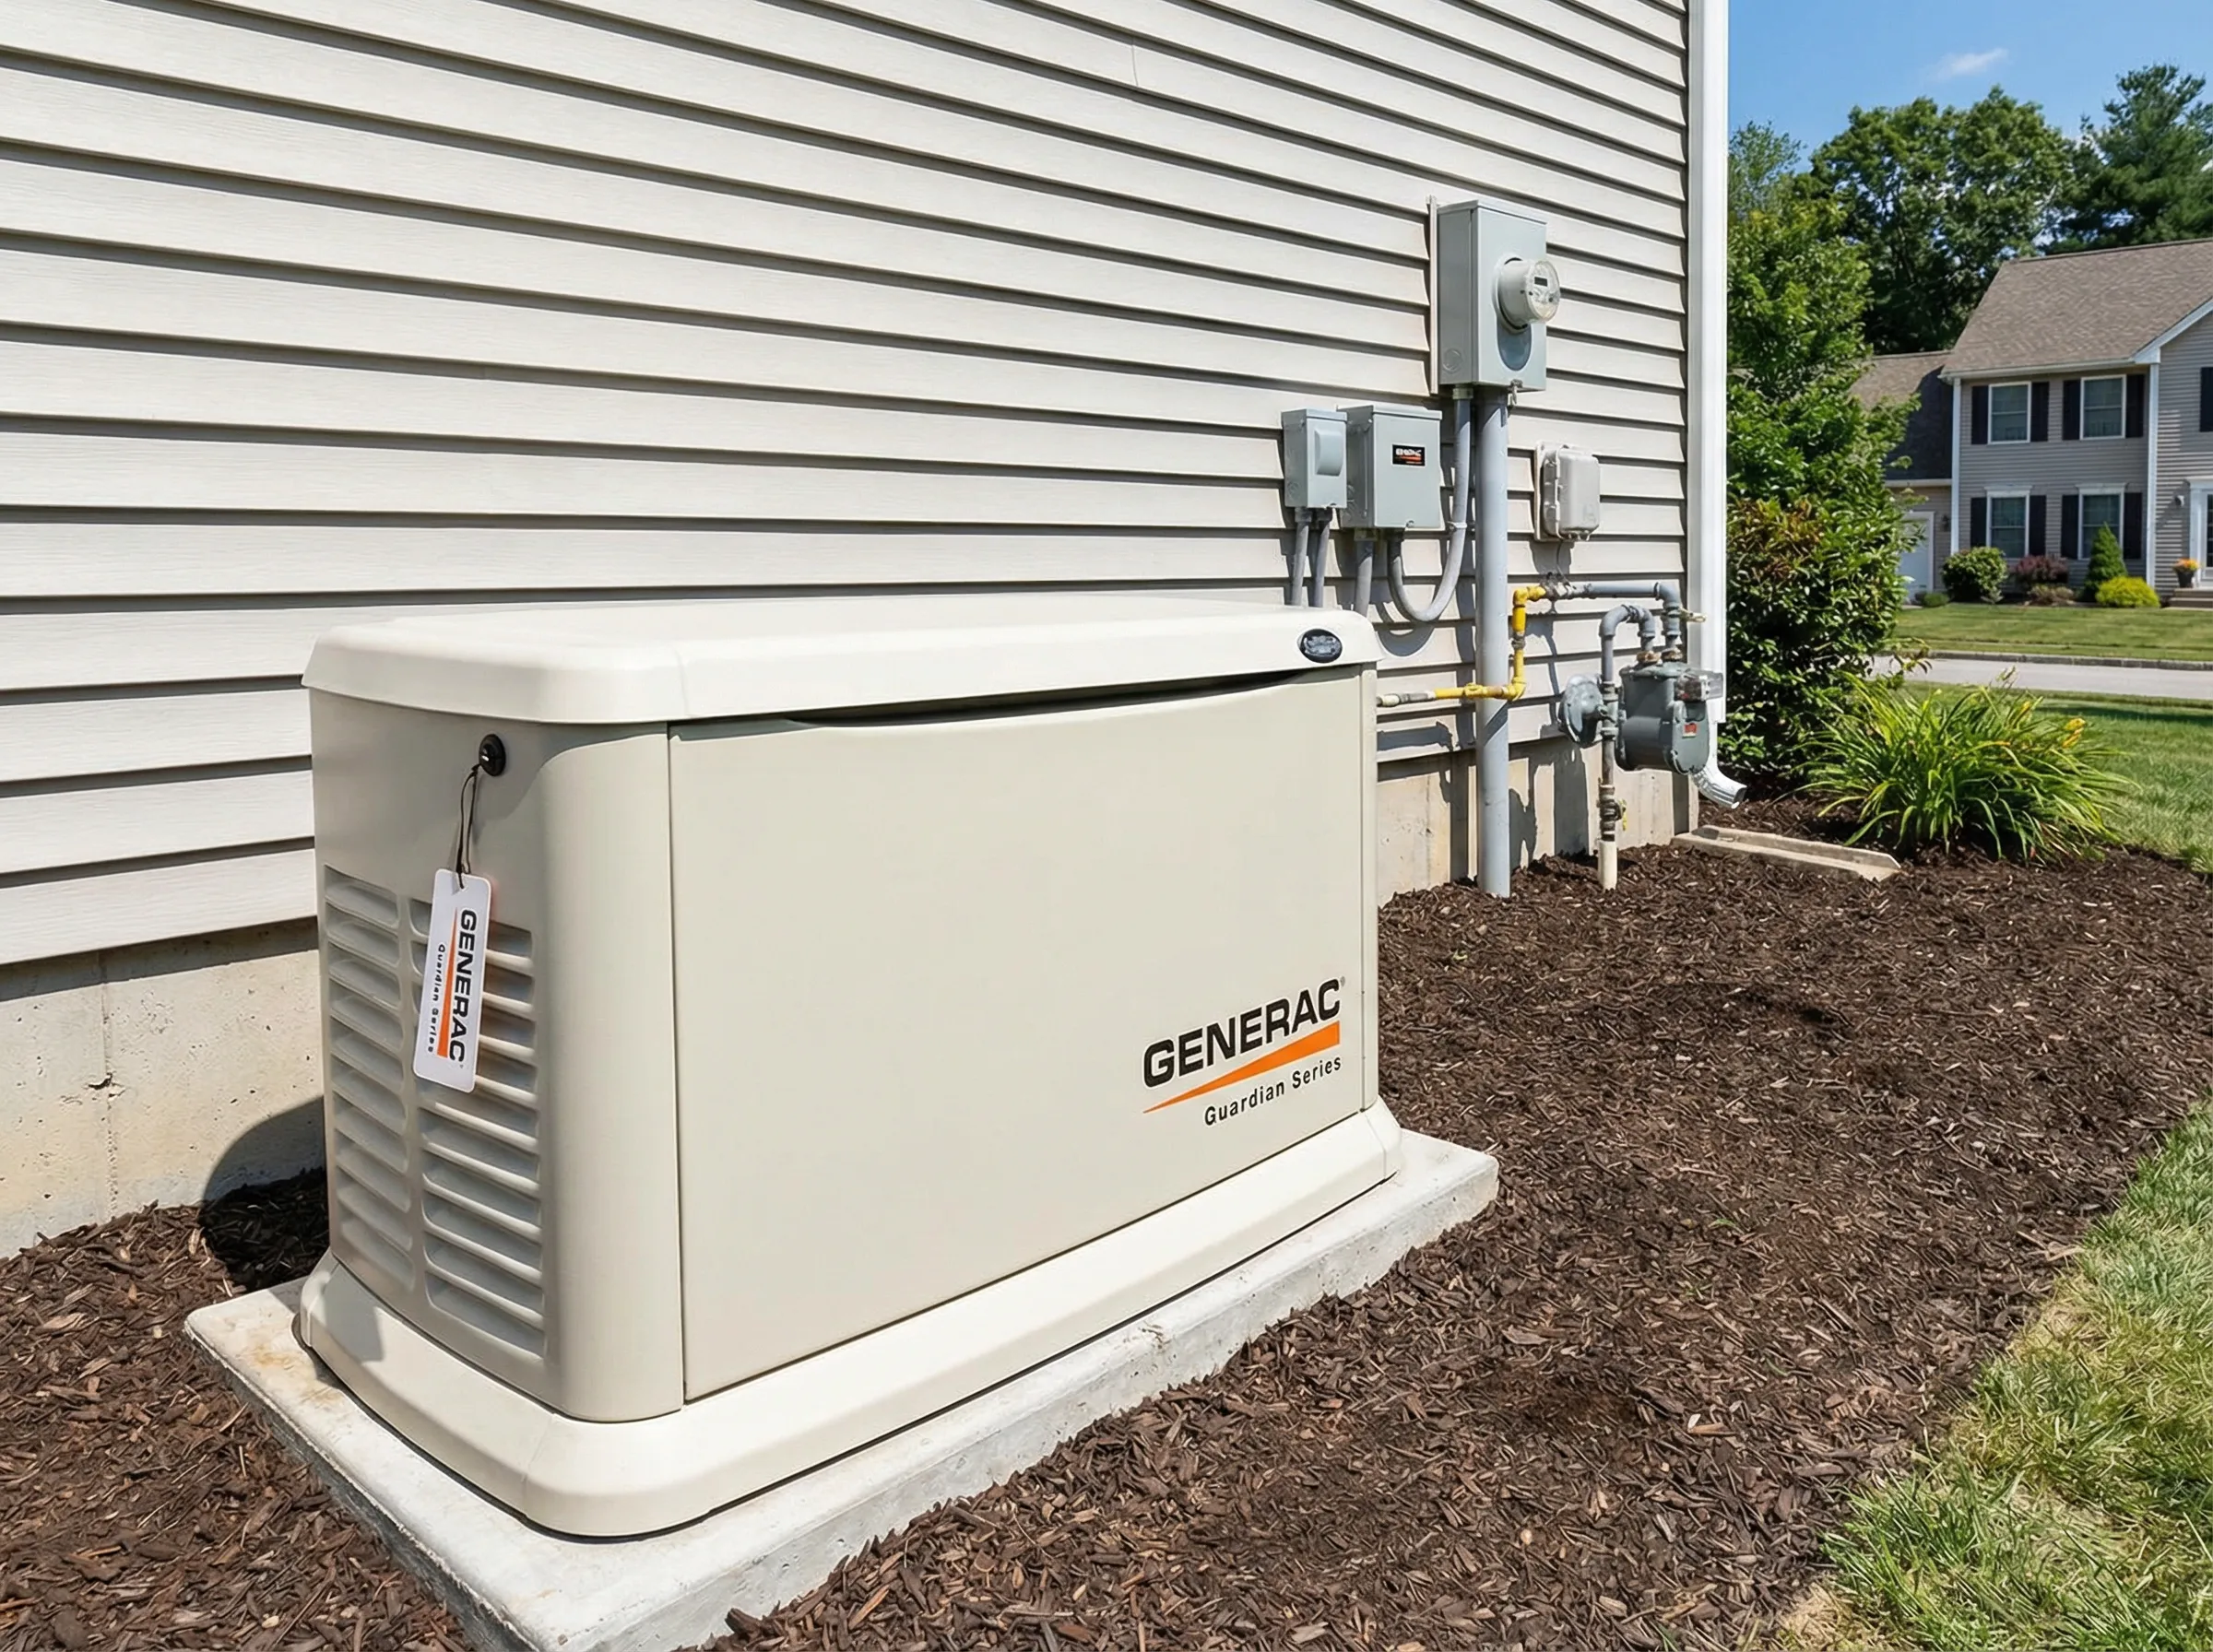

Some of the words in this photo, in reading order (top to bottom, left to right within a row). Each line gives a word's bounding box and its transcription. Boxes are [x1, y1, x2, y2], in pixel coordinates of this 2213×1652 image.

[449, 909, 477, 1062] GENERAC
[1143, 979, 1340, 1087] GENERAC
[1204, 1081, 1284, 1126] Guardian
[1292, 1056, 1341, 1089] Series
